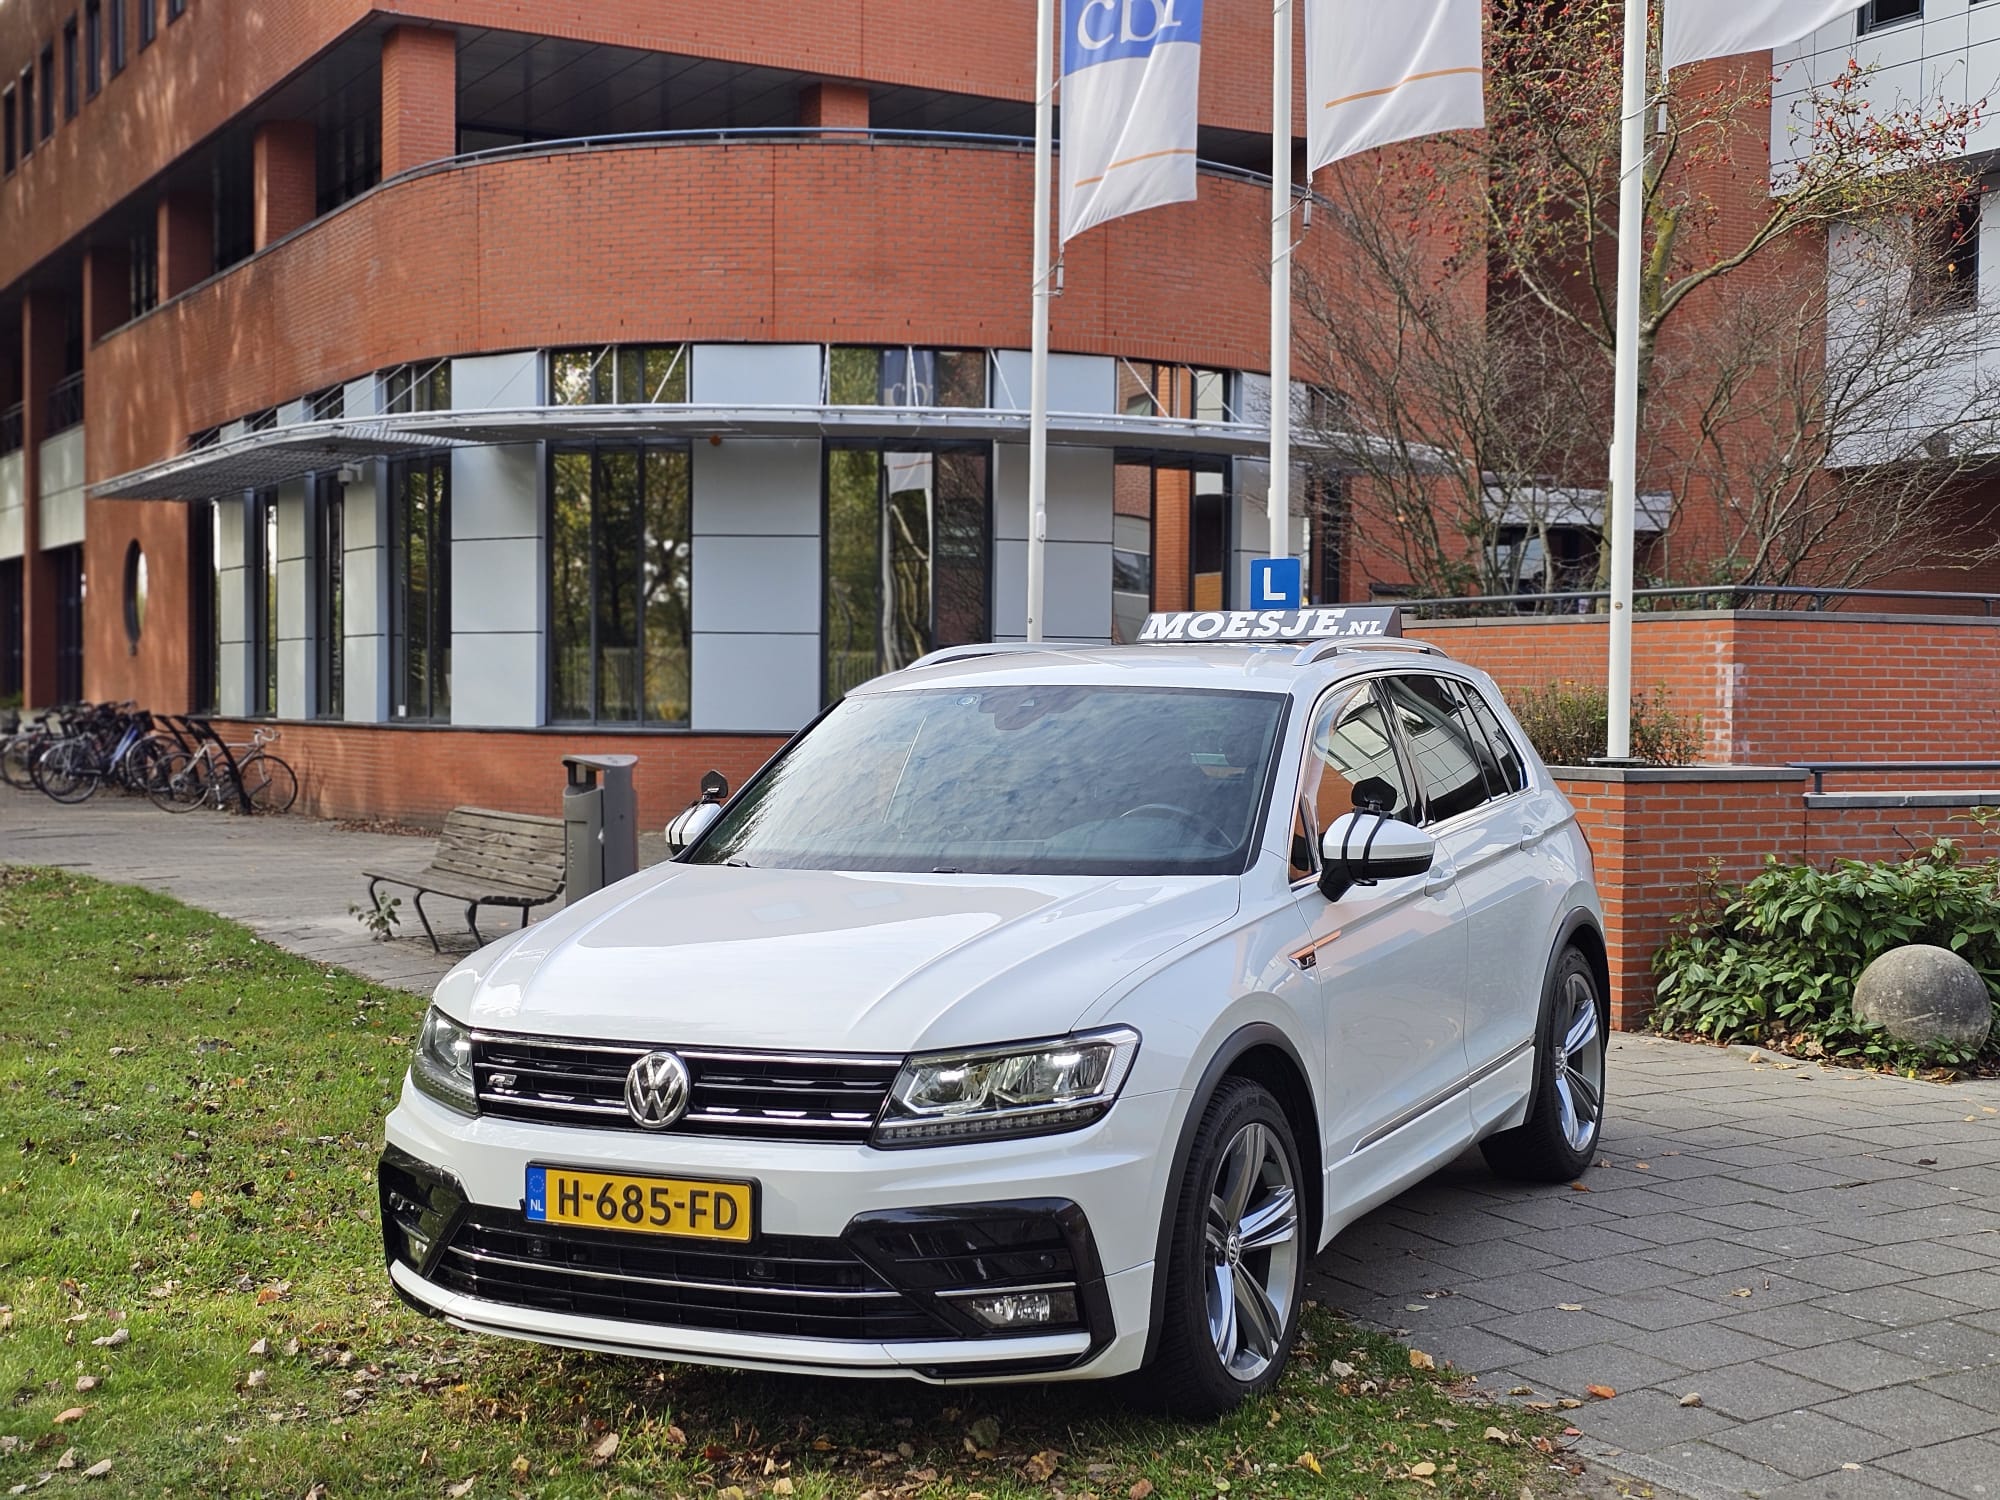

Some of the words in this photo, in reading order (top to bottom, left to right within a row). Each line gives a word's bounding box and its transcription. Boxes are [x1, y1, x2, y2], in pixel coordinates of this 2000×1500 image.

[1263, 567, 1286, 601] L
[1140, 608, 1383, 640] MOESJE.NL
[530, 1198, 544, 1212] NL
[558, 1178, 738, 1231] H-685-FD
